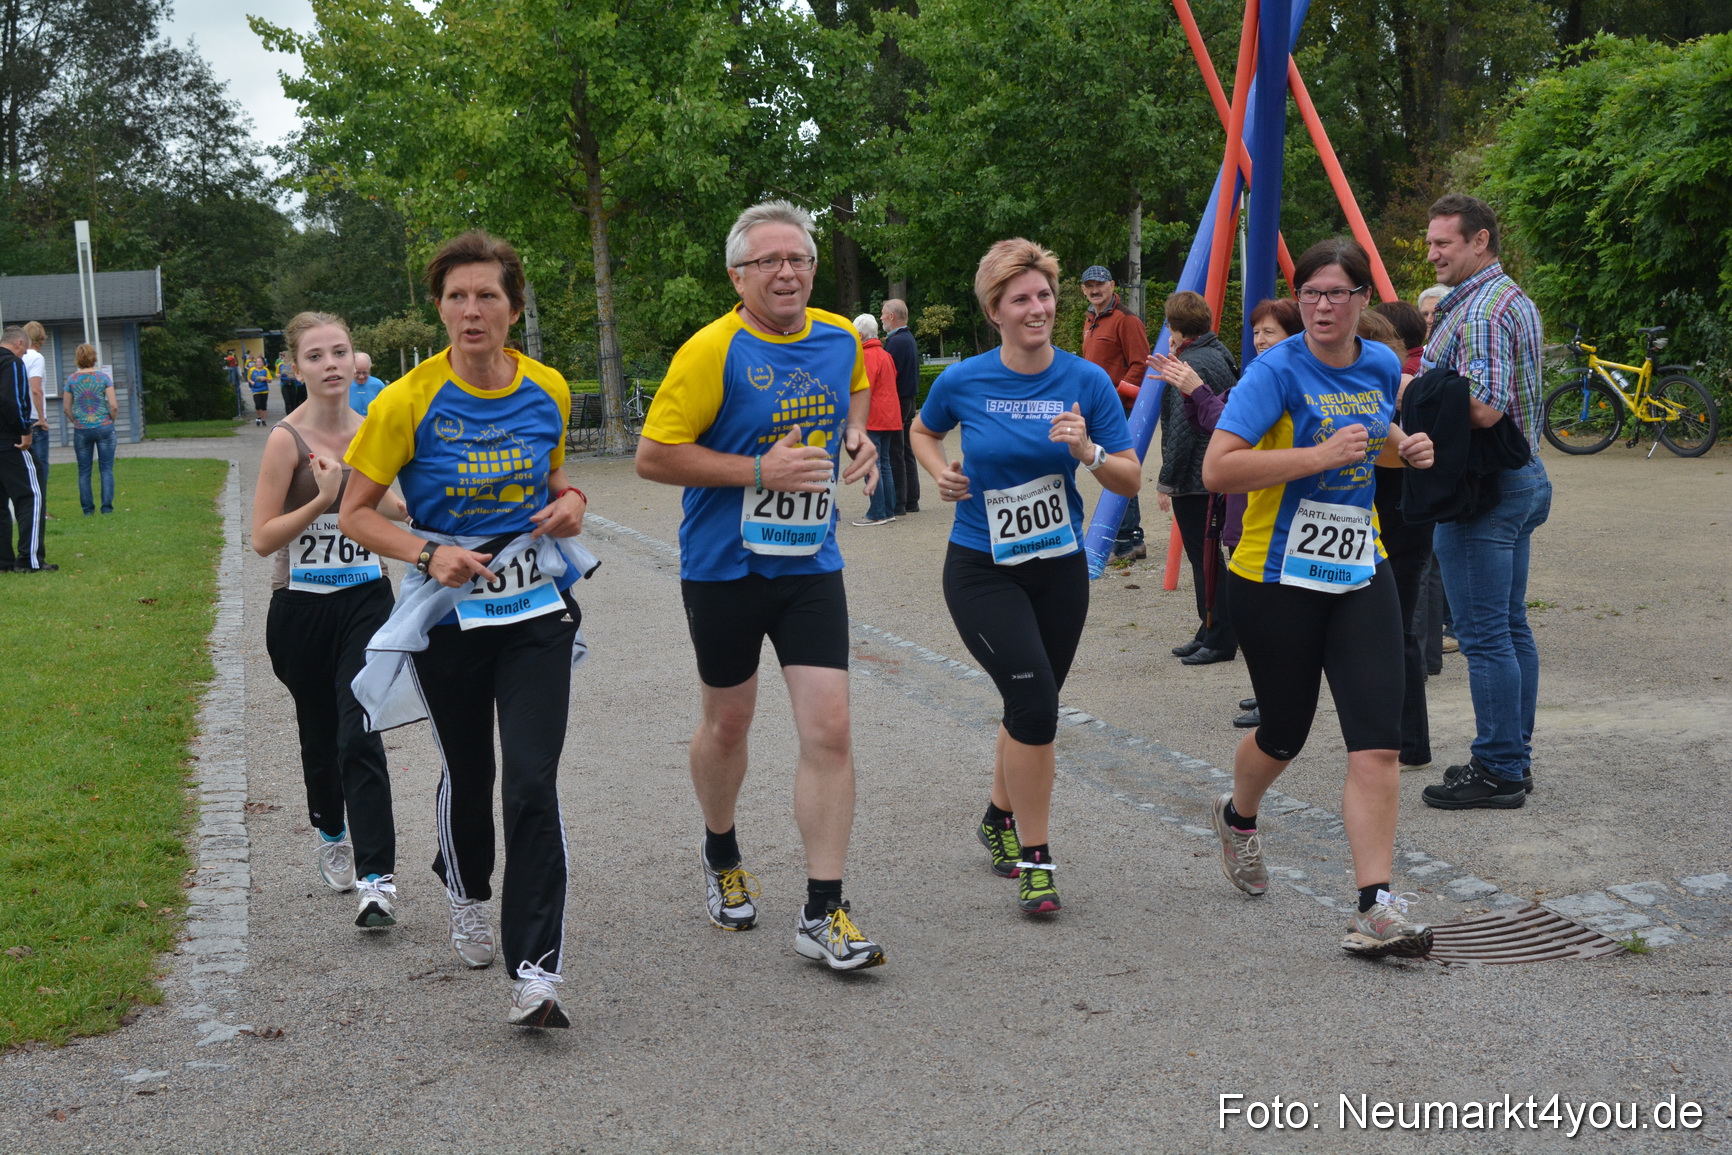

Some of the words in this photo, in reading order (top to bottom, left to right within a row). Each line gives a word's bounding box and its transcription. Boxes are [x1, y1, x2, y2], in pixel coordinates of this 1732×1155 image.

[988, 400, 1063, 413] SPORTWEISS
[1319, 391, 1384, 404] NEUMARKTR
[1321, 403, 1380, 416] STADTLAUF
[460, 475, 512, 485] 21.September
[514, 472, 533, 481] 2014
[754, 488, 830, 520] 2616
[987, 496, 1016, 506] PARTL
[1017, 484, 1052, 502] Neumarkt
[997, 494, 1063, 538] 2608
[1296, 507, 1327, 520] PARTL
[1329, 513, 1363, 524] Neumarkt
[762, 528, 817, 545] Wolfgang
[1012, 535, 1062, 554] Christine
[1297, 523, 1367, 560] 2287
[300, 534, 371, 564] 2764
[304, 572, 369, 584] Grossmann
[1309, 564, 1352, 583] Birgitta
[485, 598, 531, 616] Renate
